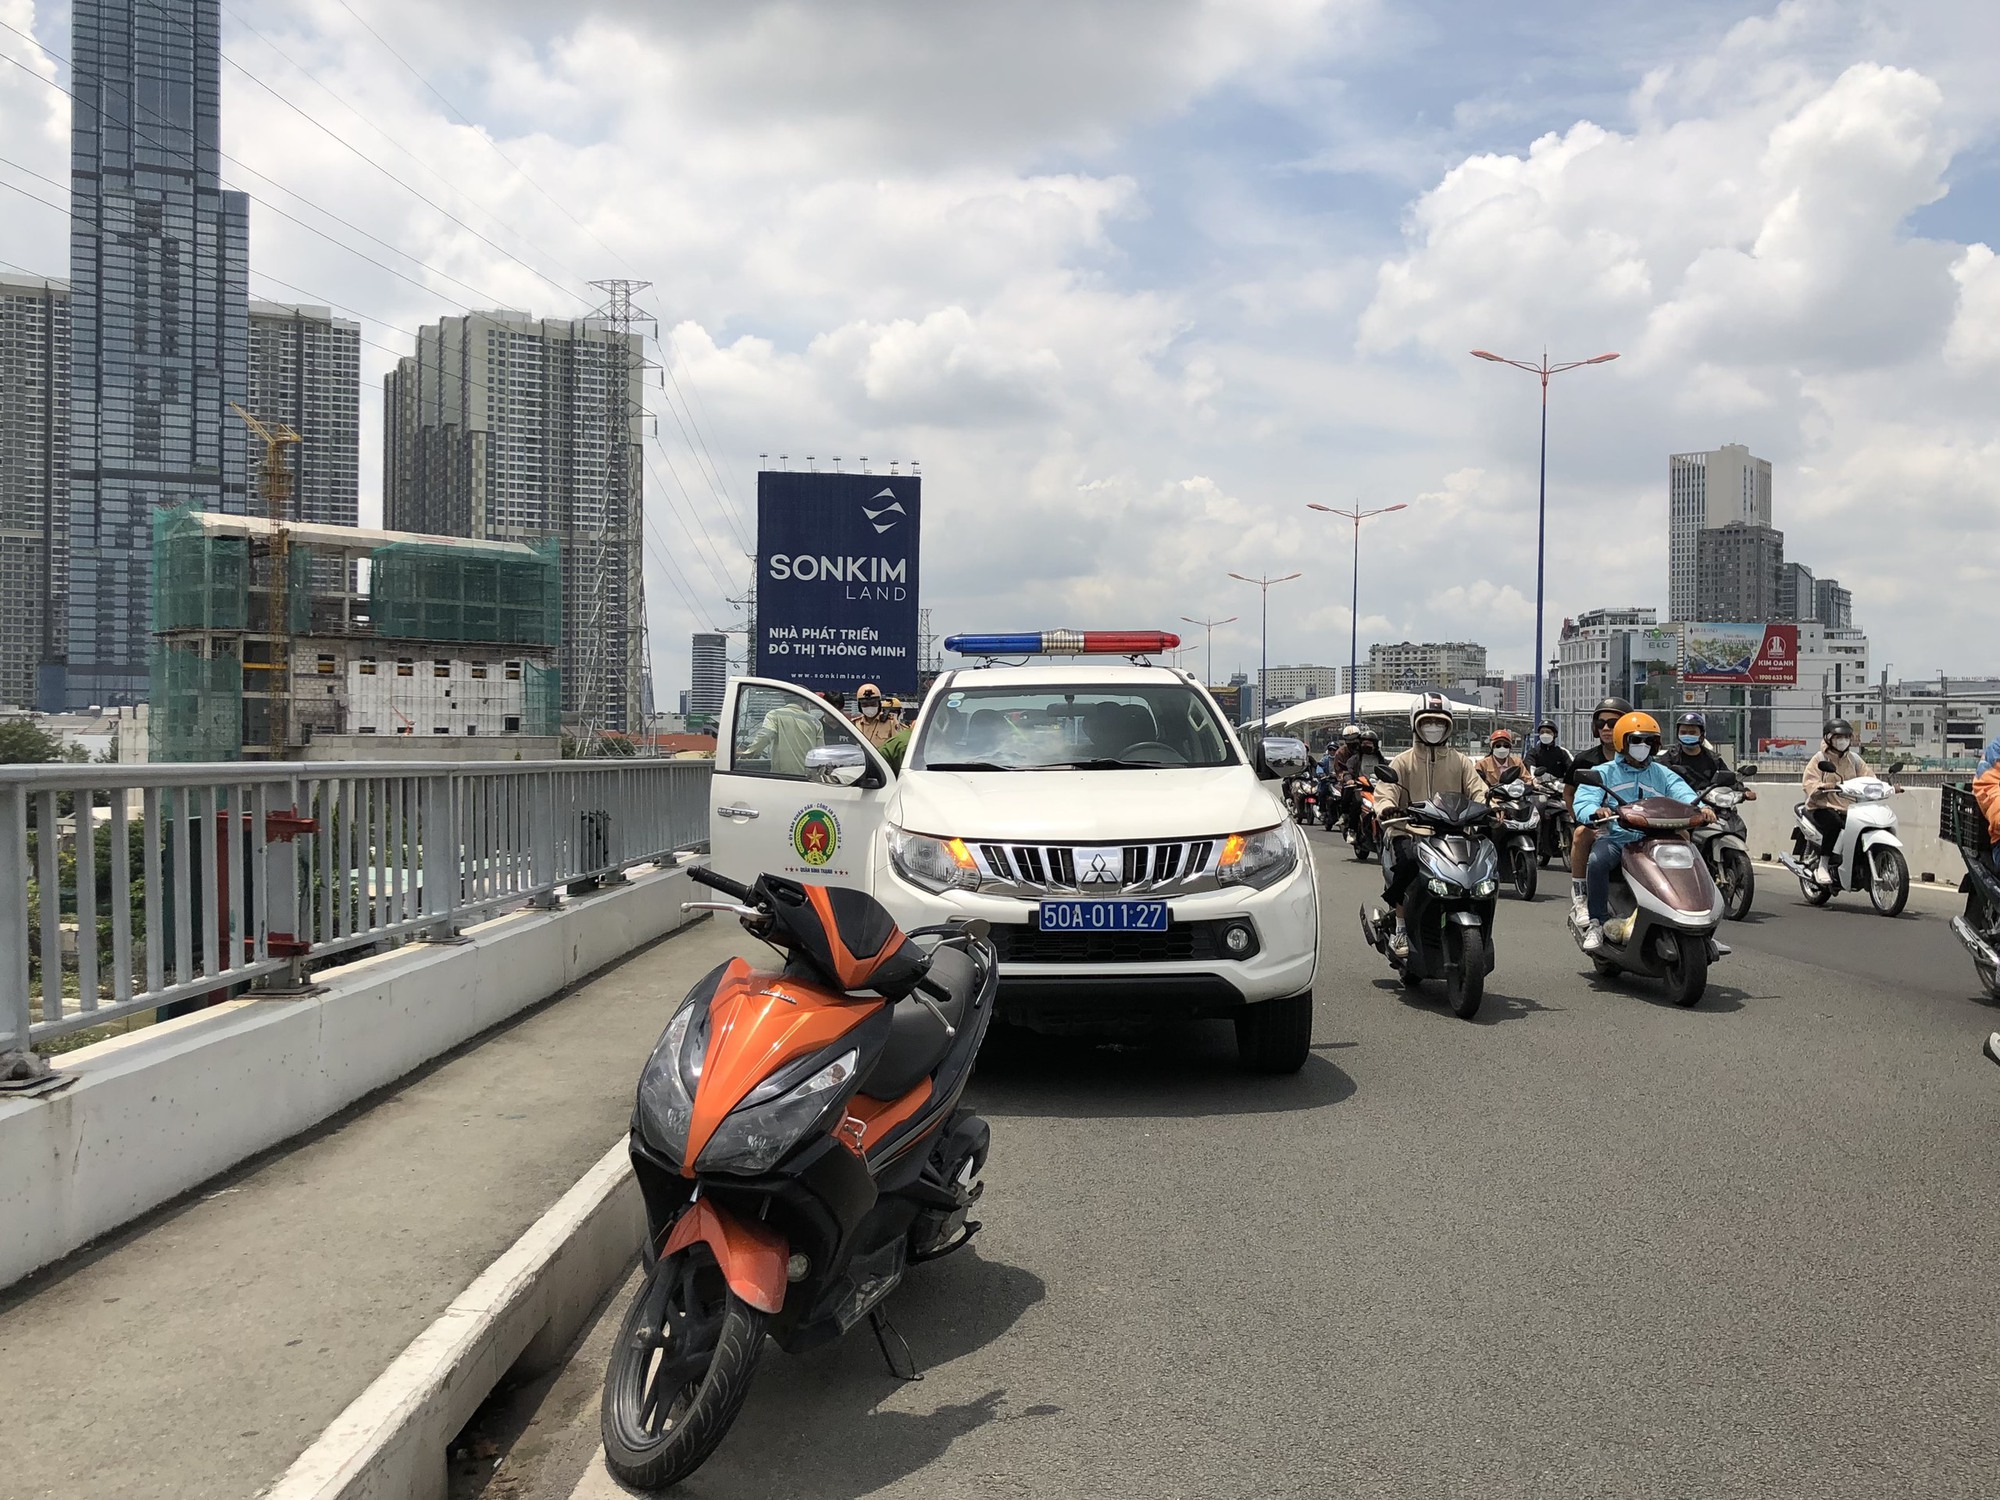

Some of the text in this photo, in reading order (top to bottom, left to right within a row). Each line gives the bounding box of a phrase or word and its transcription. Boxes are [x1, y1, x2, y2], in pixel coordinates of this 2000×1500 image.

[769, 553, 907, 583] SONKIM
[846, 585, 907, 601] LAND
[769, 625, 879, 641] NHÀ PHÁT TRIỂN
[793, 643, 815, 658] THỊ
[818, 642, 867, 656] THÔNG
[871, 646, 906, 657] MINH
[1758, 659, 1794, 667] KIM OANH
[1044, 904, 1162, 928] 50A-011.27
